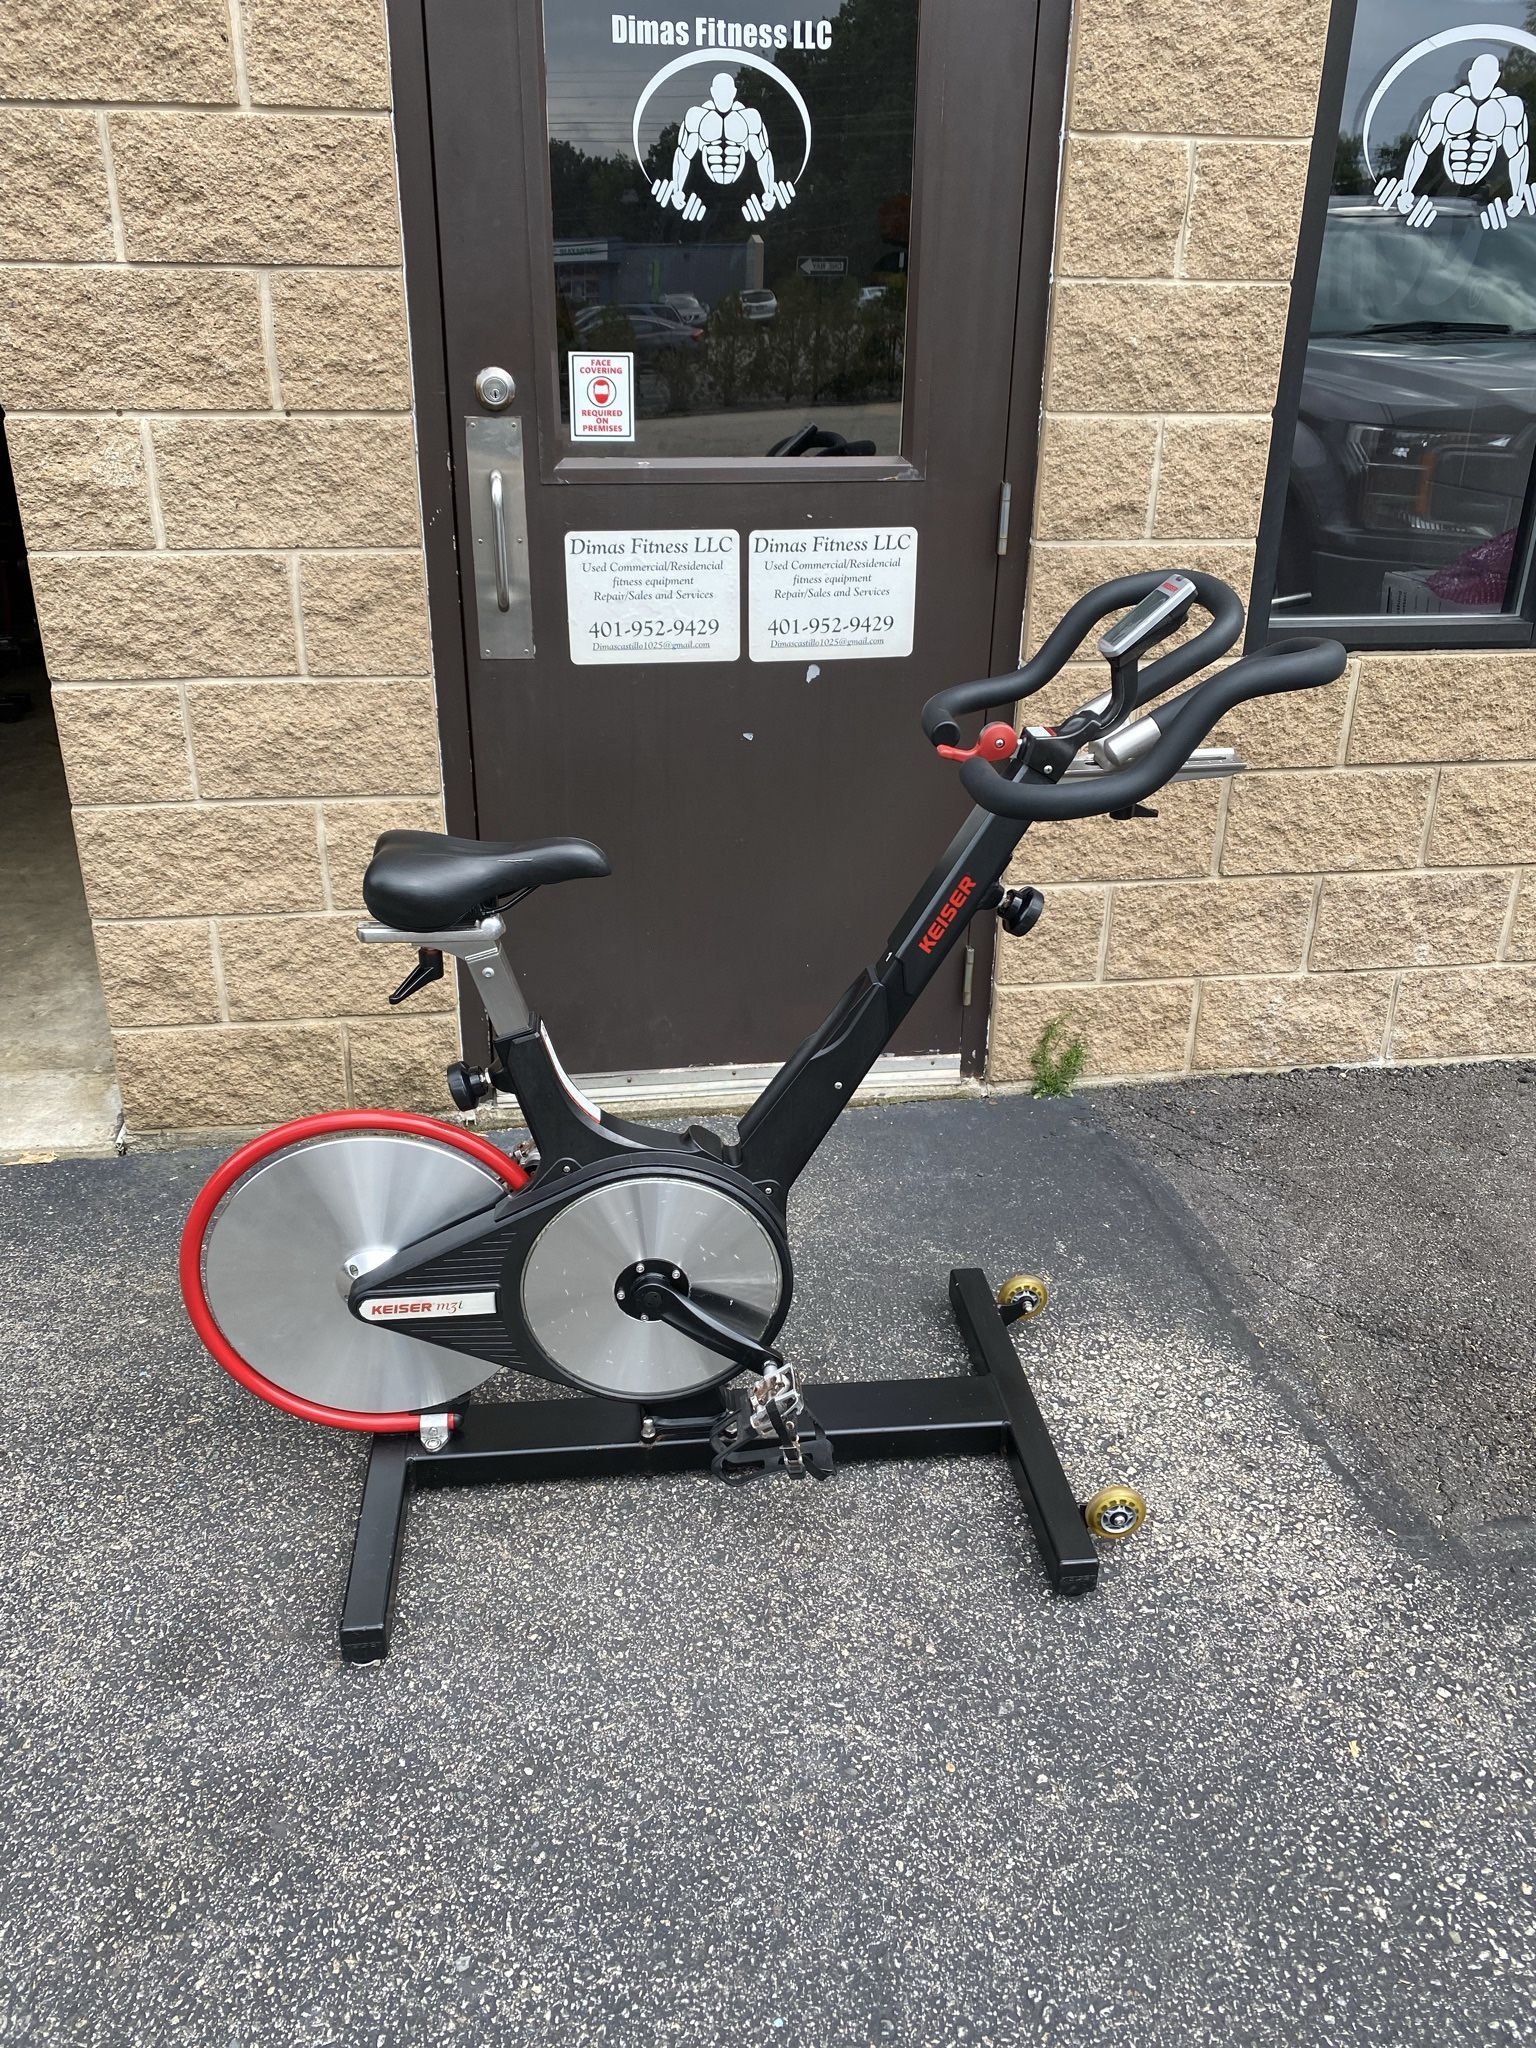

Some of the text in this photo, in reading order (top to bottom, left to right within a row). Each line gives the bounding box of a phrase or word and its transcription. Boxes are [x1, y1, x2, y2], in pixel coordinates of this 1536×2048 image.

[611, 14, 833, 50] Dimas Fitness LLC
[581, 409, 623, 417] REQUIRED
[570, 536, 733, 555] Dimas Fitness LLC
[753, 533, 911, 554] Dimas Fitness LLC
[582, 560, 724, 573] Used Commercial/Residencial
[764, 558, 901, 571] Used Commercial/Residencial
[612, 576, 694, 588] fitness equipment
[793, 574, 872, 586] fitness equipment
[593, 589, 714, 603] Repair/Sales and Services
[774, 587, 890, 600] Repair/Sales and Services
[589, 618, 720, 639] 401-952-9429
[768, 615, 894, 636] 401-952-9429
[592, 640, 711, 652] Dimascastillo1025@gmail.com
[770, 637, 885, 649] Dimascastillo1025@gmail.com
[918, 873, 977, 955] KEISER
[371, 1302, 433, 1315] KEISER
